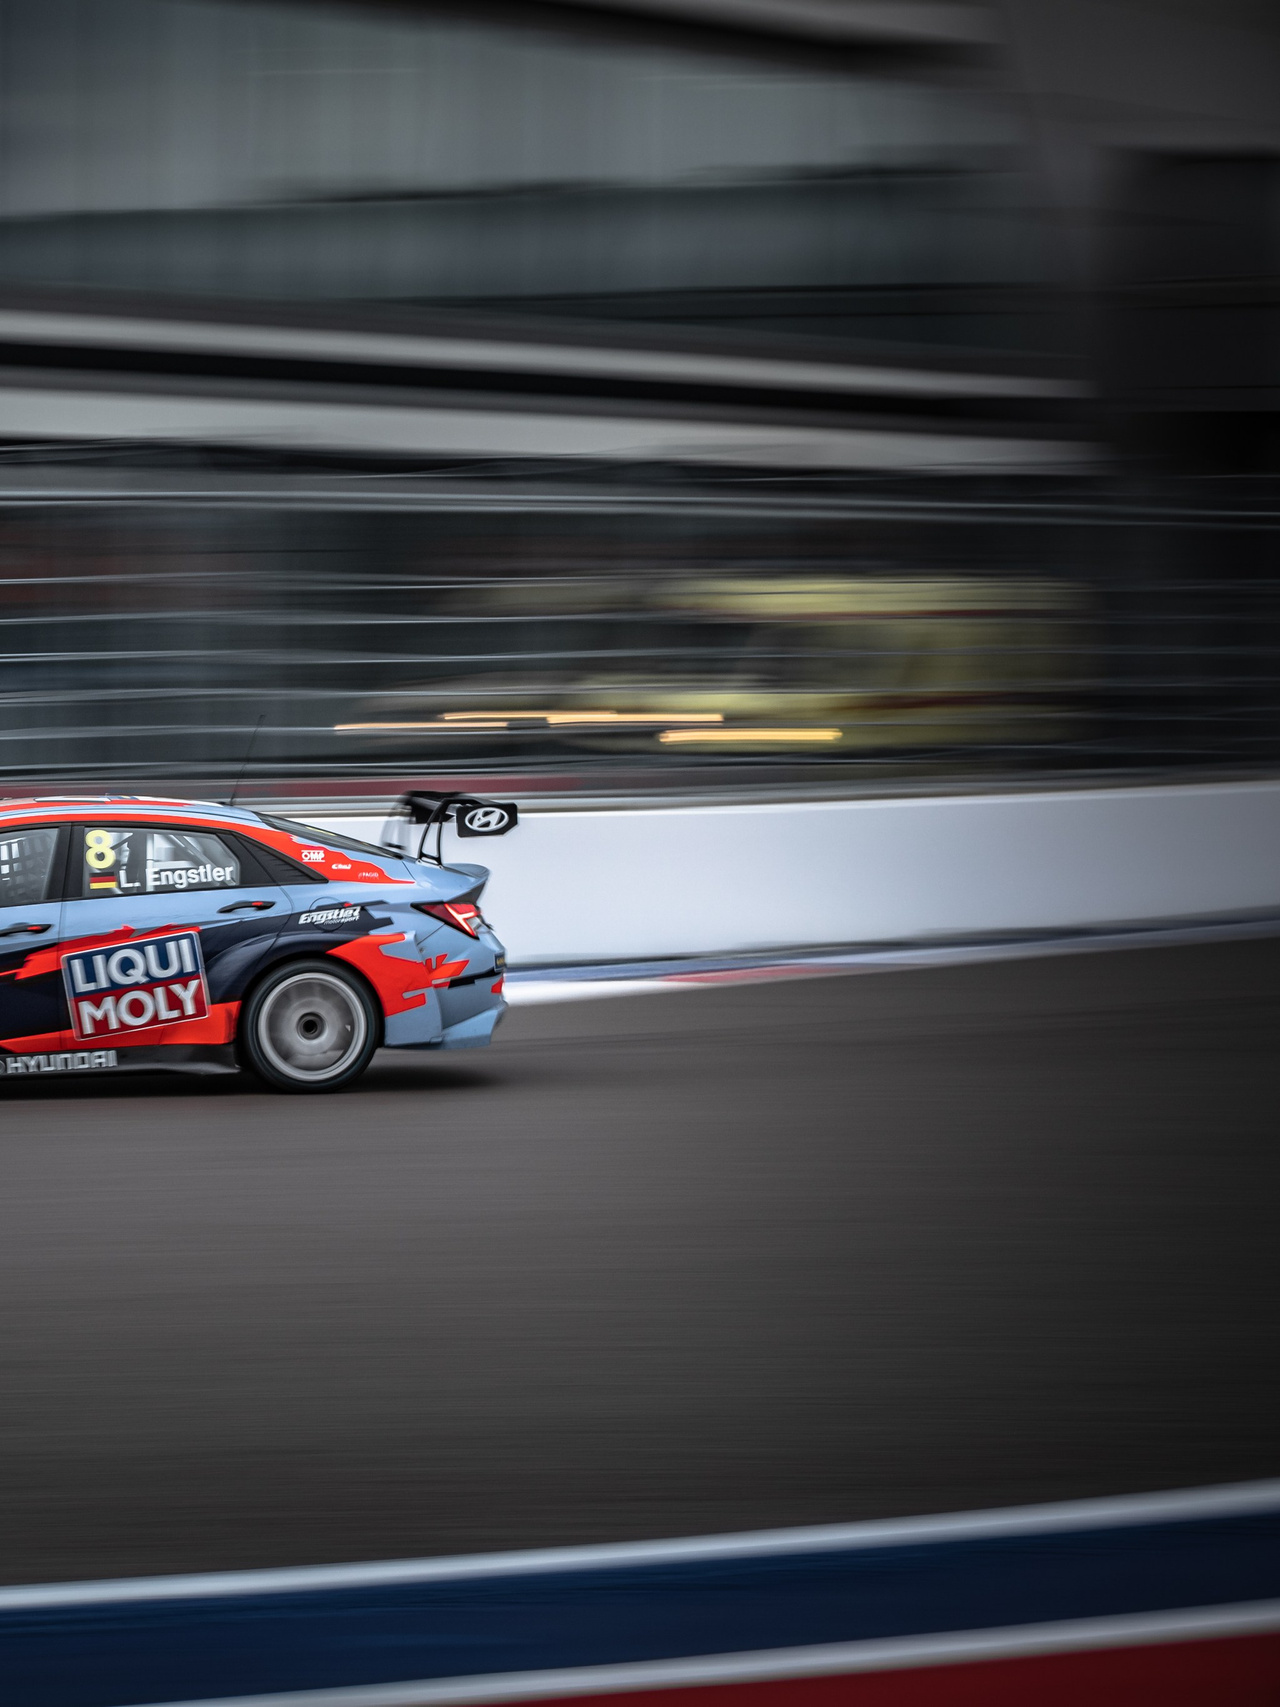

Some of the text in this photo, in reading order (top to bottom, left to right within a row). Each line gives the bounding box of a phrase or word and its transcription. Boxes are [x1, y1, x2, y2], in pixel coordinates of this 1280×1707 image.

[85, 829, 116, 869] 8
[301, 852, 325, 860] OMP
[119, 863, 233, 889] L. Engstler
[298, 907, 361, 925] Engstler
[70, 939, 197, 994] LIQUI
[78, 979, 201, 1035] MOLY
[6, 1050, 118, 1074] HYUNDAI
